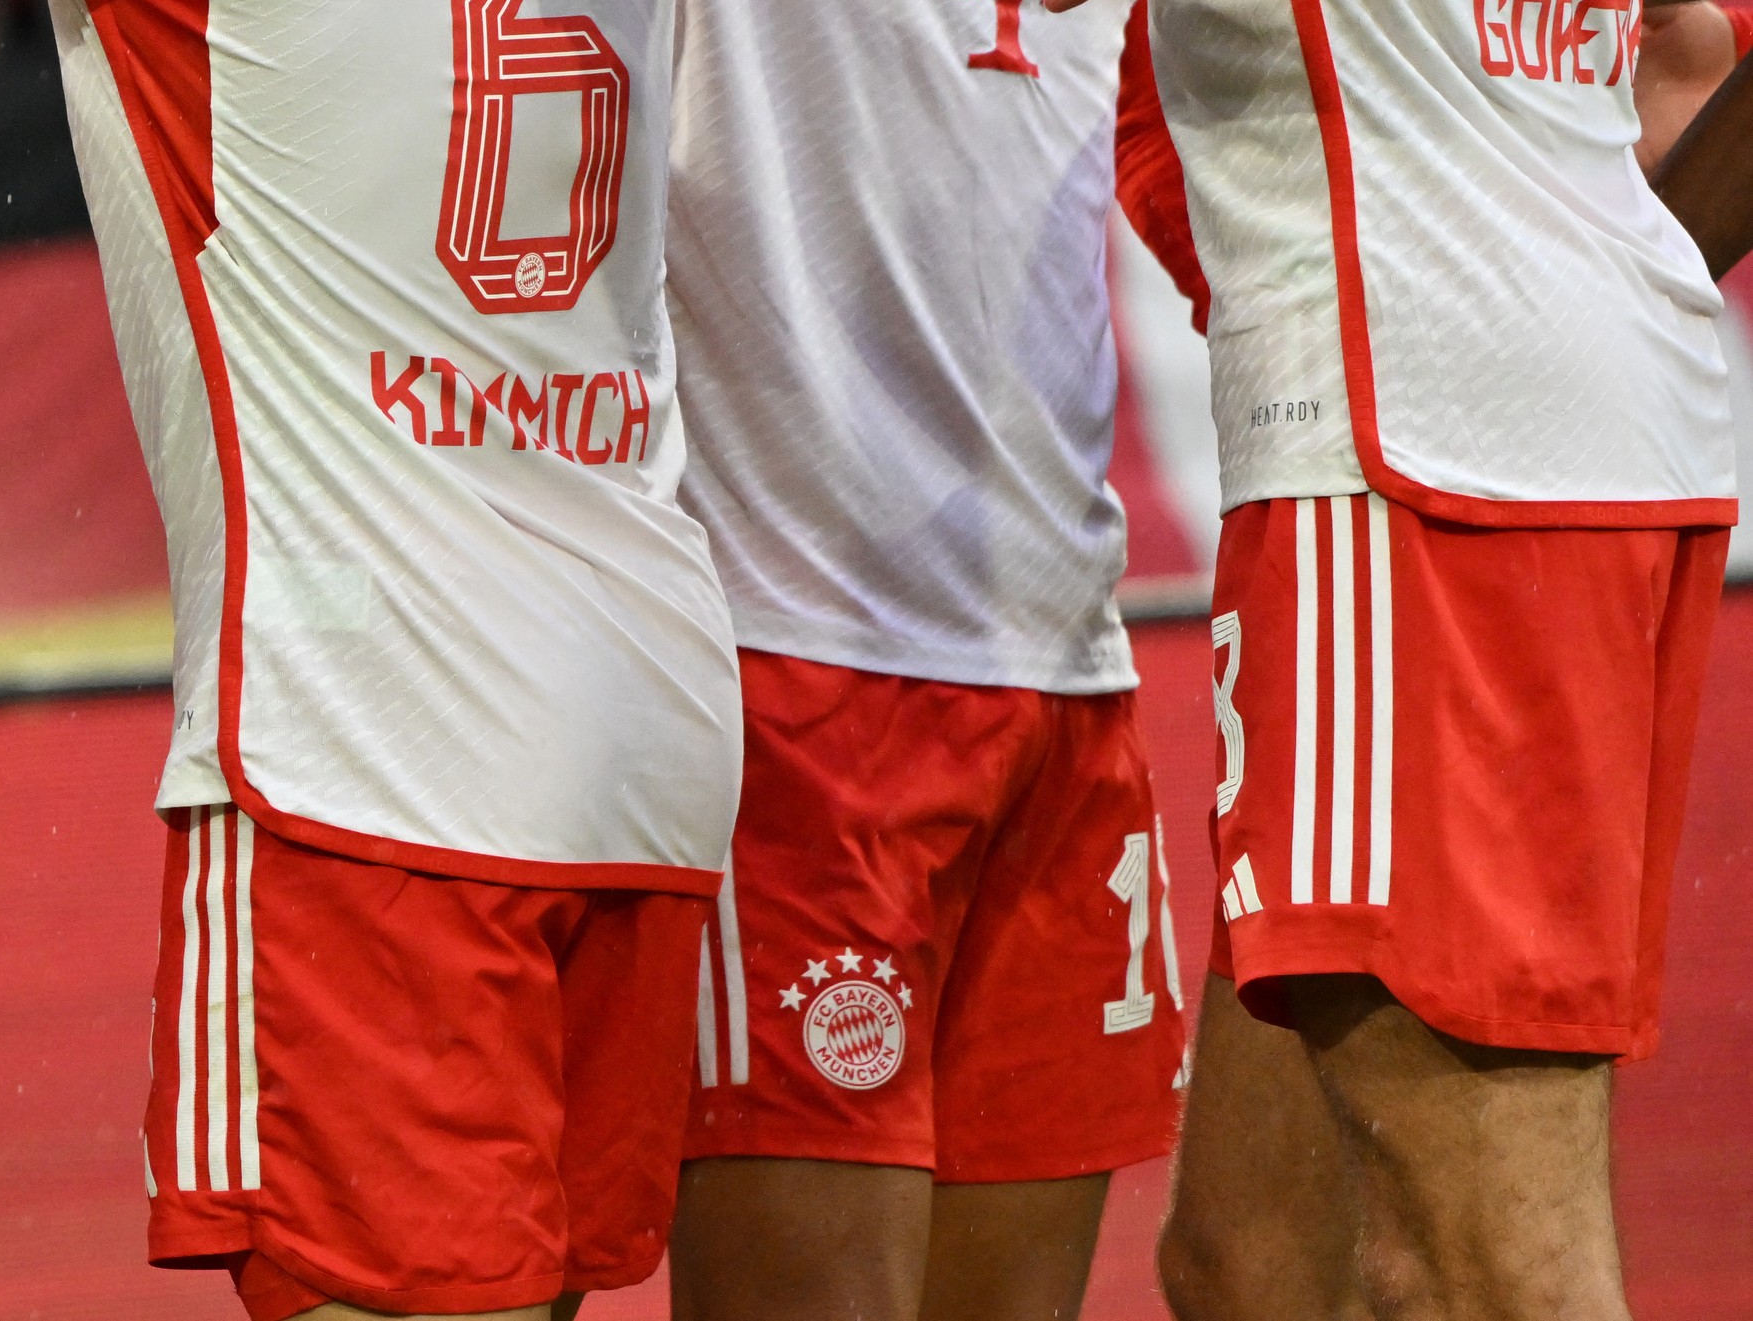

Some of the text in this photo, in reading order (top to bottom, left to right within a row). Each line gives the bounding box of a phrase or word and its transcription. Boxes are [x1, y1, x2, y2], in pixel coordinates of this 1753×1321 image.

[1250, 400, 1320, 428] HEAT.RDY
[813, 988, 897, 1029] FC BAYERN
